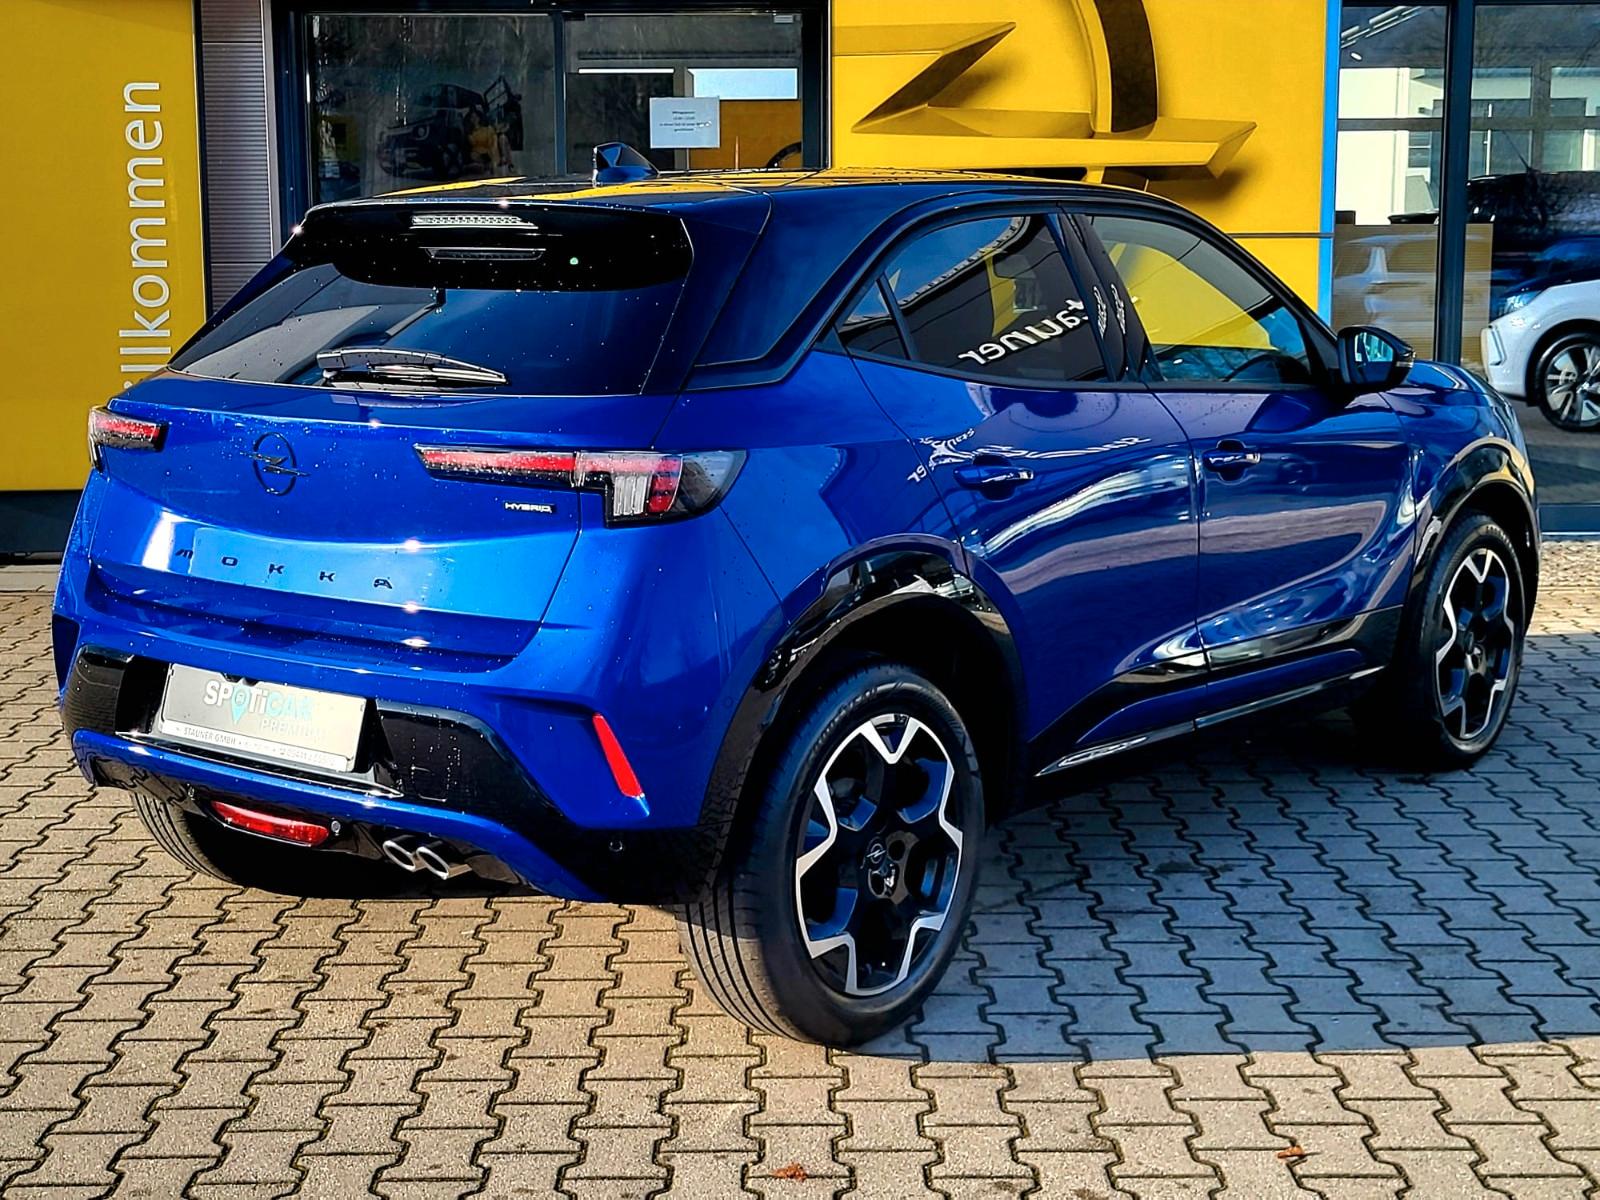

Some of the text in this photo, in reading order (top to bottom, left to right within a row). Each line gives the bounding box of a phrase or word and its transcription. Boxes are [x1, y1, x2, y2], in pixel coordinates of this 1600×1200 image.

[119, 81, 172, 388] llkommen
[505, 502, 553, 514] HYBRID
[175, 548, 393, 590] MOKKA
